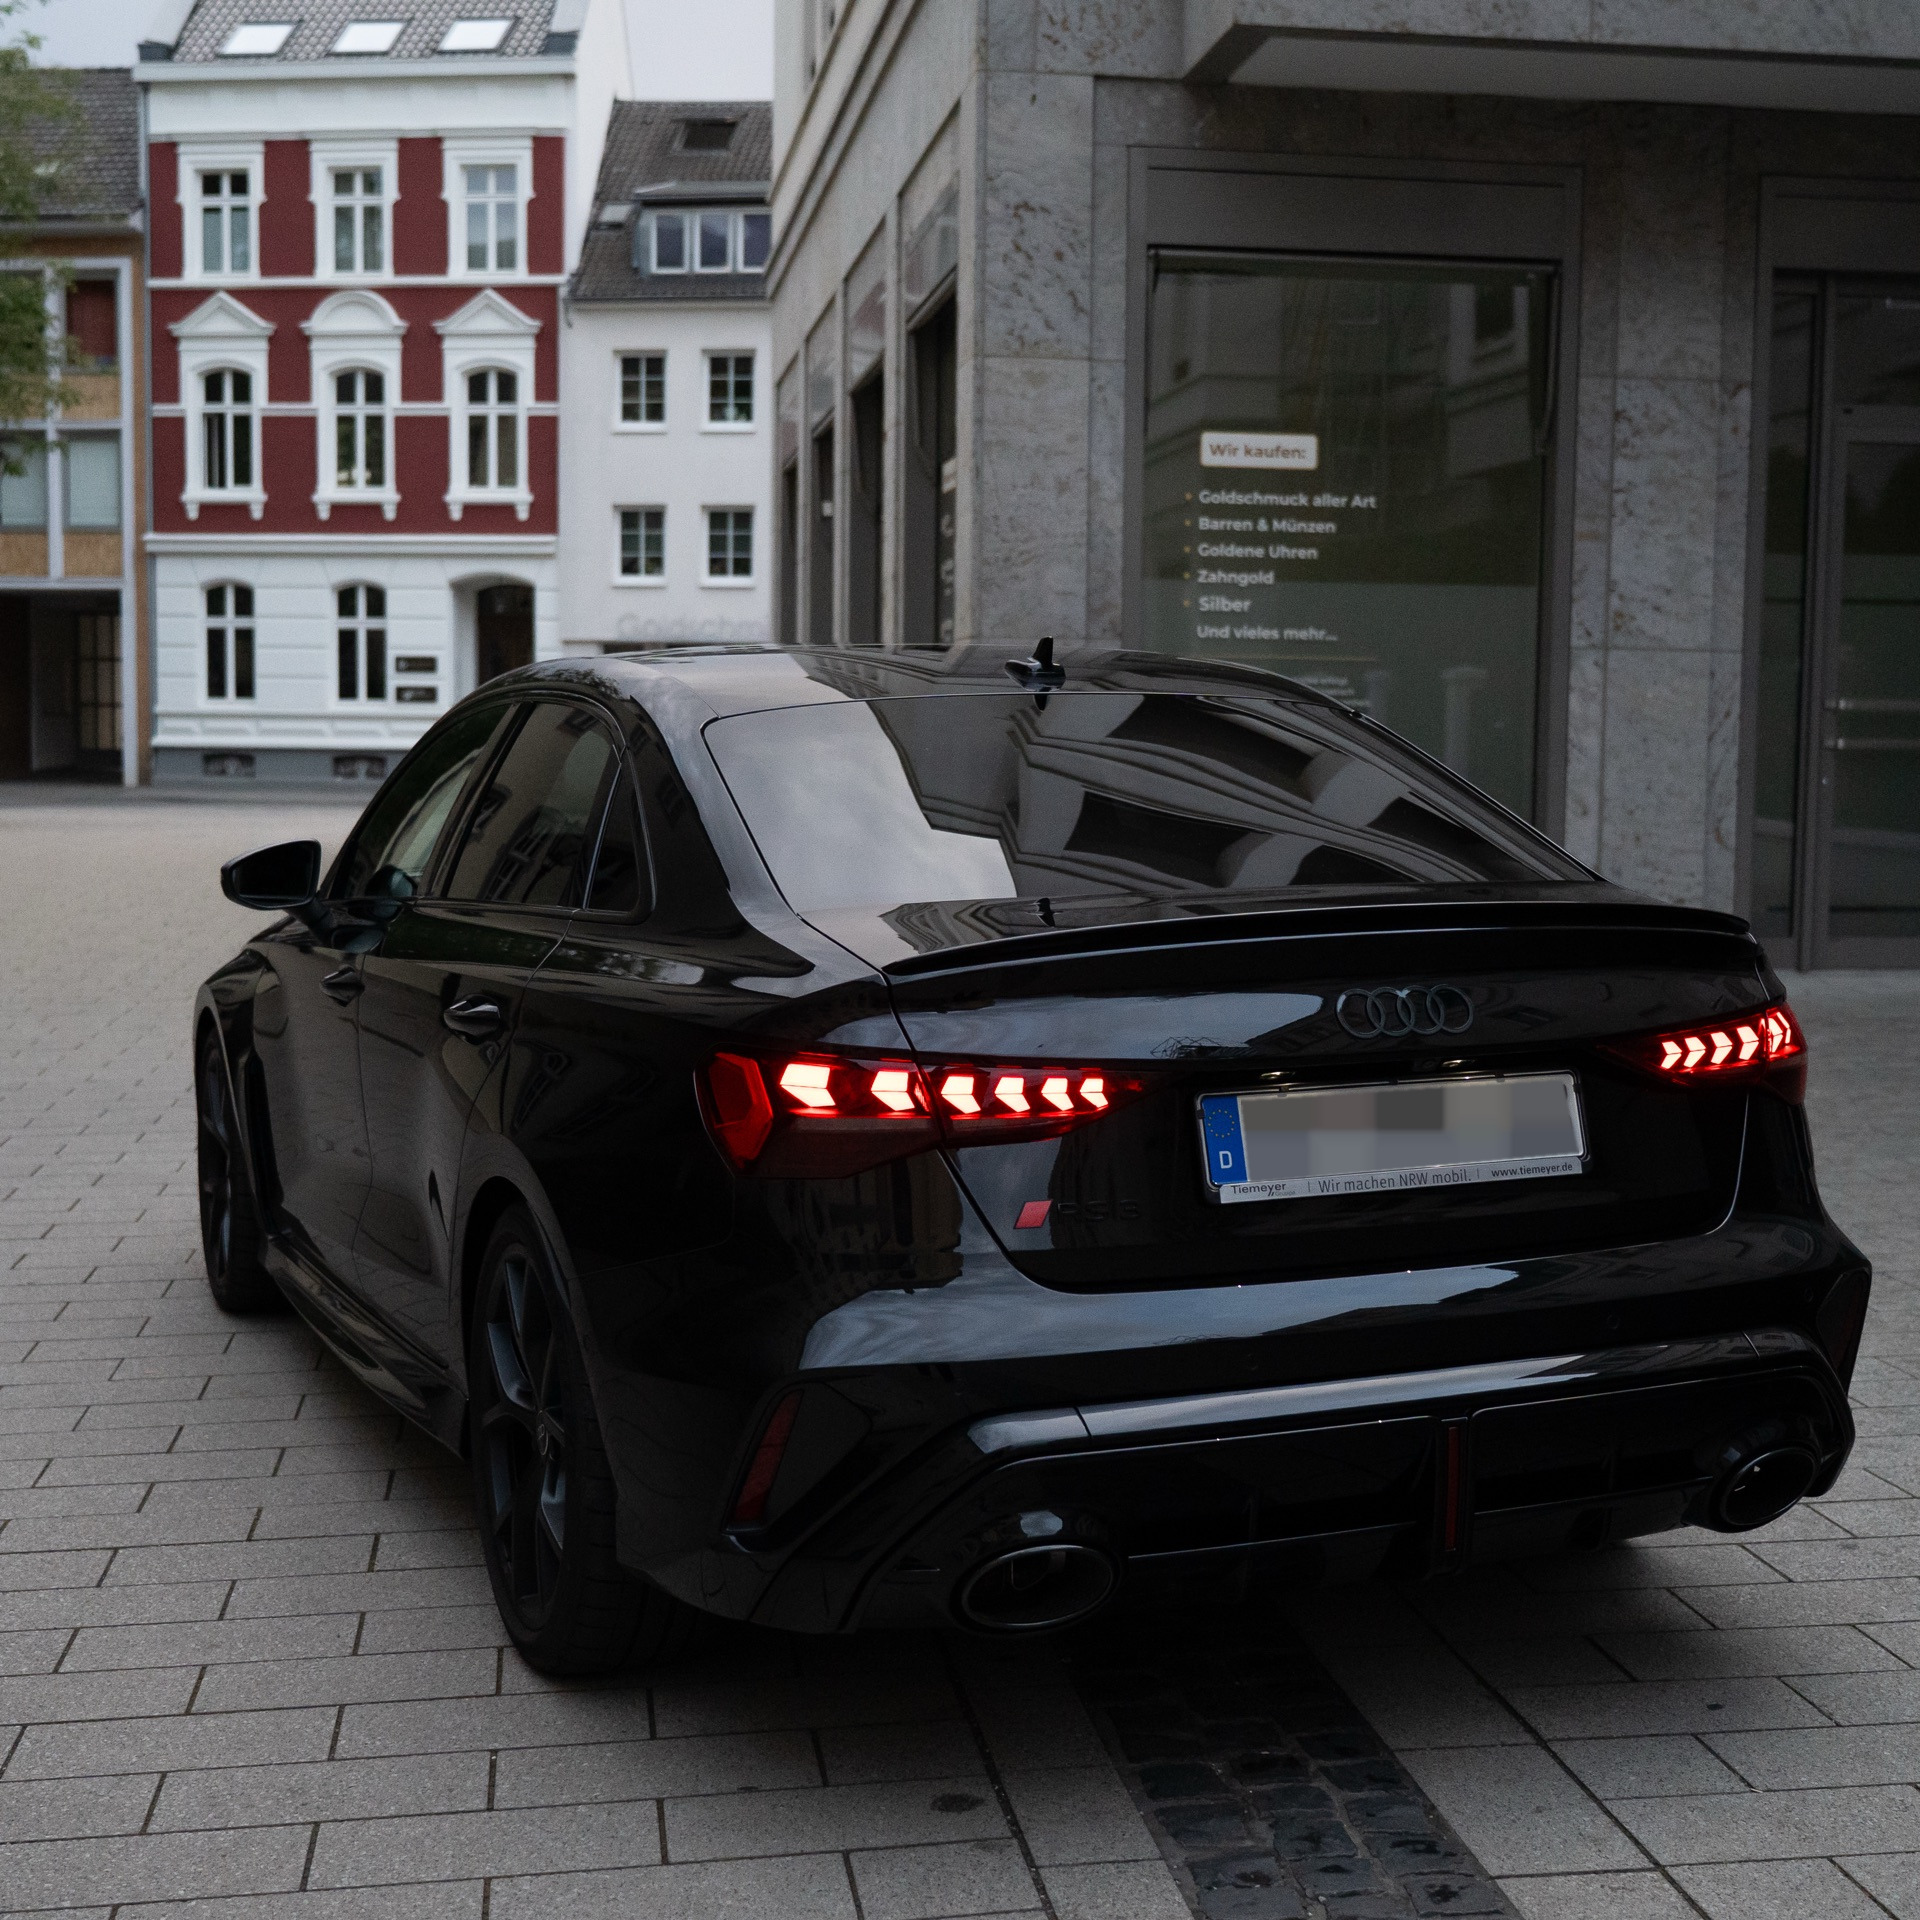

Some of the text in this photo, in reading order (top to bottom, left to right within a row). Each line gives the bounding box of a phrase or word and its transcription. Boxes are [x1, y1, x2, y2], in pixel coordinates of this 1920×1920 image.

[1209, 443, 1239, 457] Wir
[1199, 489, 1377, 509] Goldschmuck aller Art
[1199, 516, 1337, 533] Barren & Münzen
[1198, 542, 1319, 560] Goldene Uhren
[1198, 569, 1275, 587] Zahngold
[1199, 595, 1251, 613] Silber
[1197, 625, 1230, 639] Und
[1233, 625, 1279, 640] vieles
[1218, 1150, 1233, 1170] D
[1491, 1162, 1573, 1178] www.tiemeyer.de
[1318, 1168, 1472, 1193] Wir machen NRW mobil.
[1230, 1183, 1287, 1197] Tiemeyer
